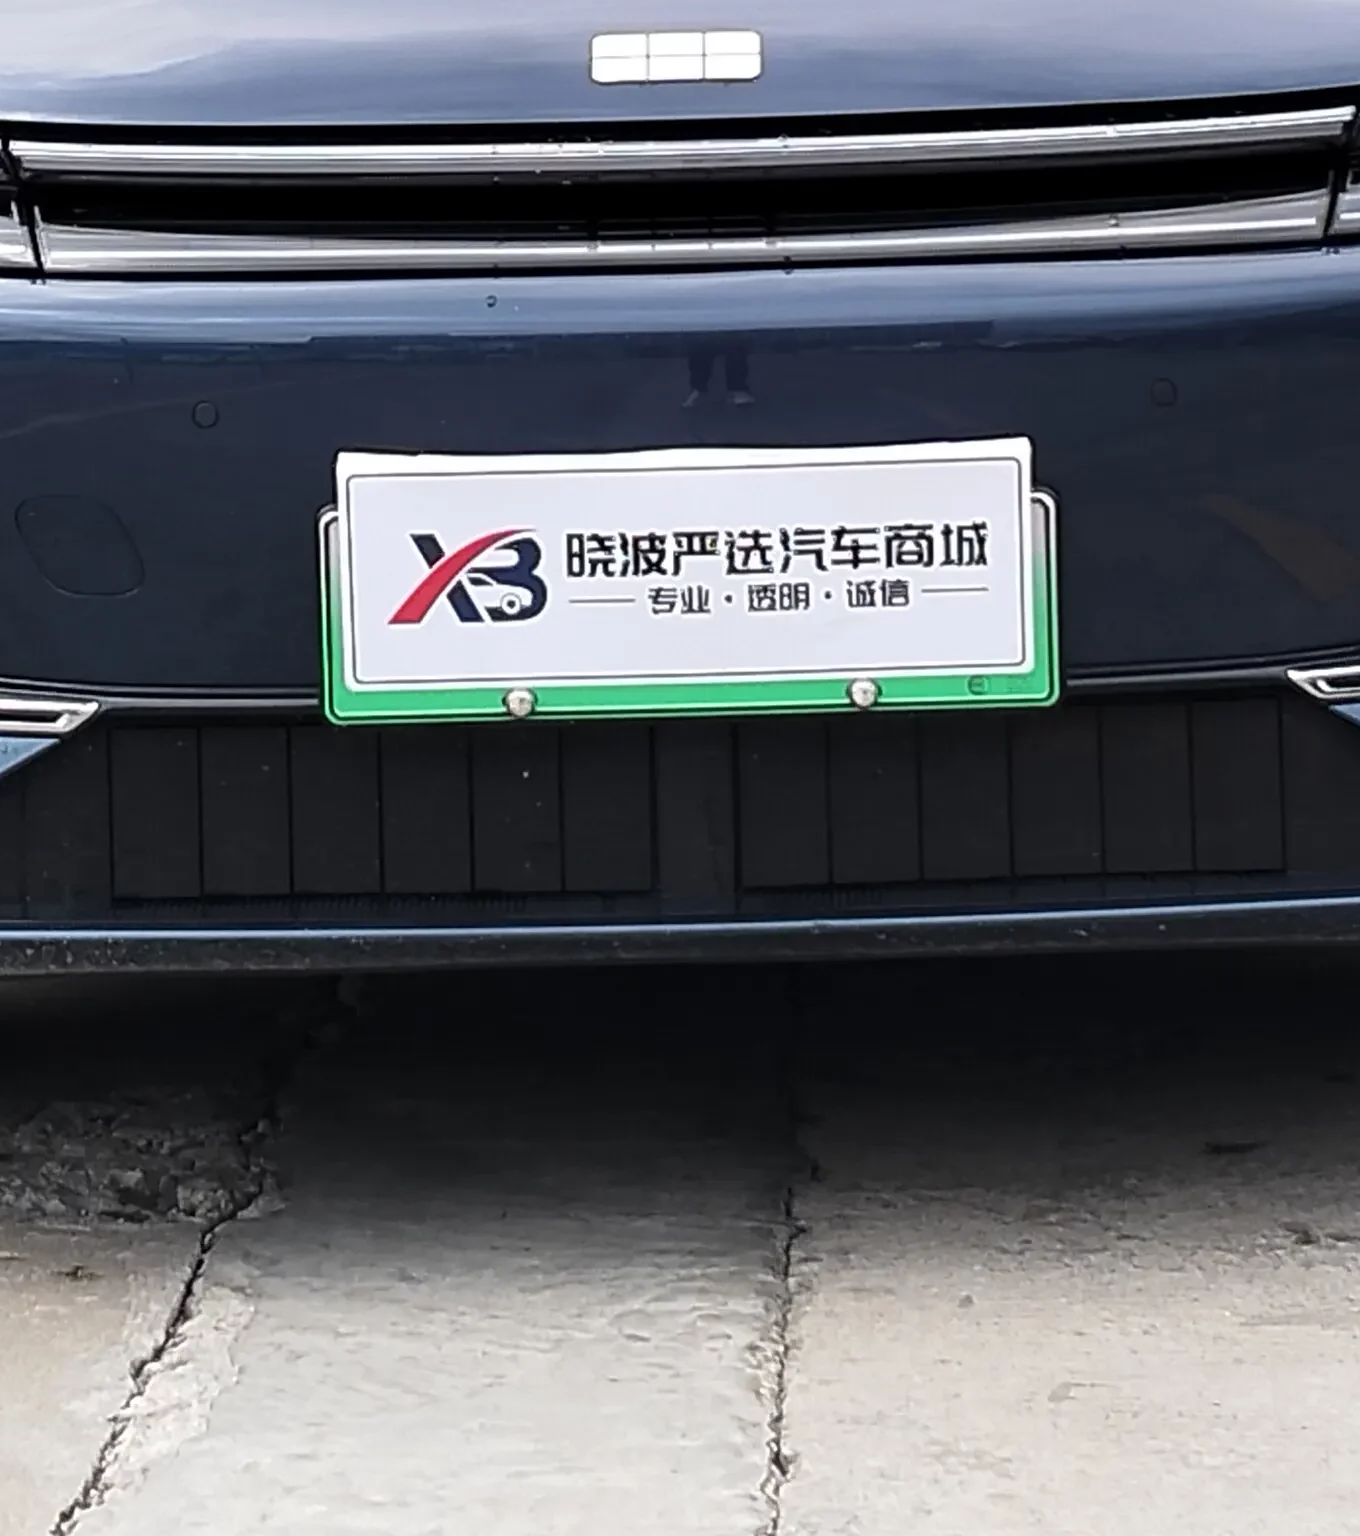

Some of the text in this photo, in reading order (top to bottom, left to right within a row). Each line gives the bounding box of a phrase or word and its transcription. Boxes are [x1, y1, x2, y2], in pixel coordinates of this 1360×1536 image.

[565, 521, 989, 578] 晓波严选汽车商城
